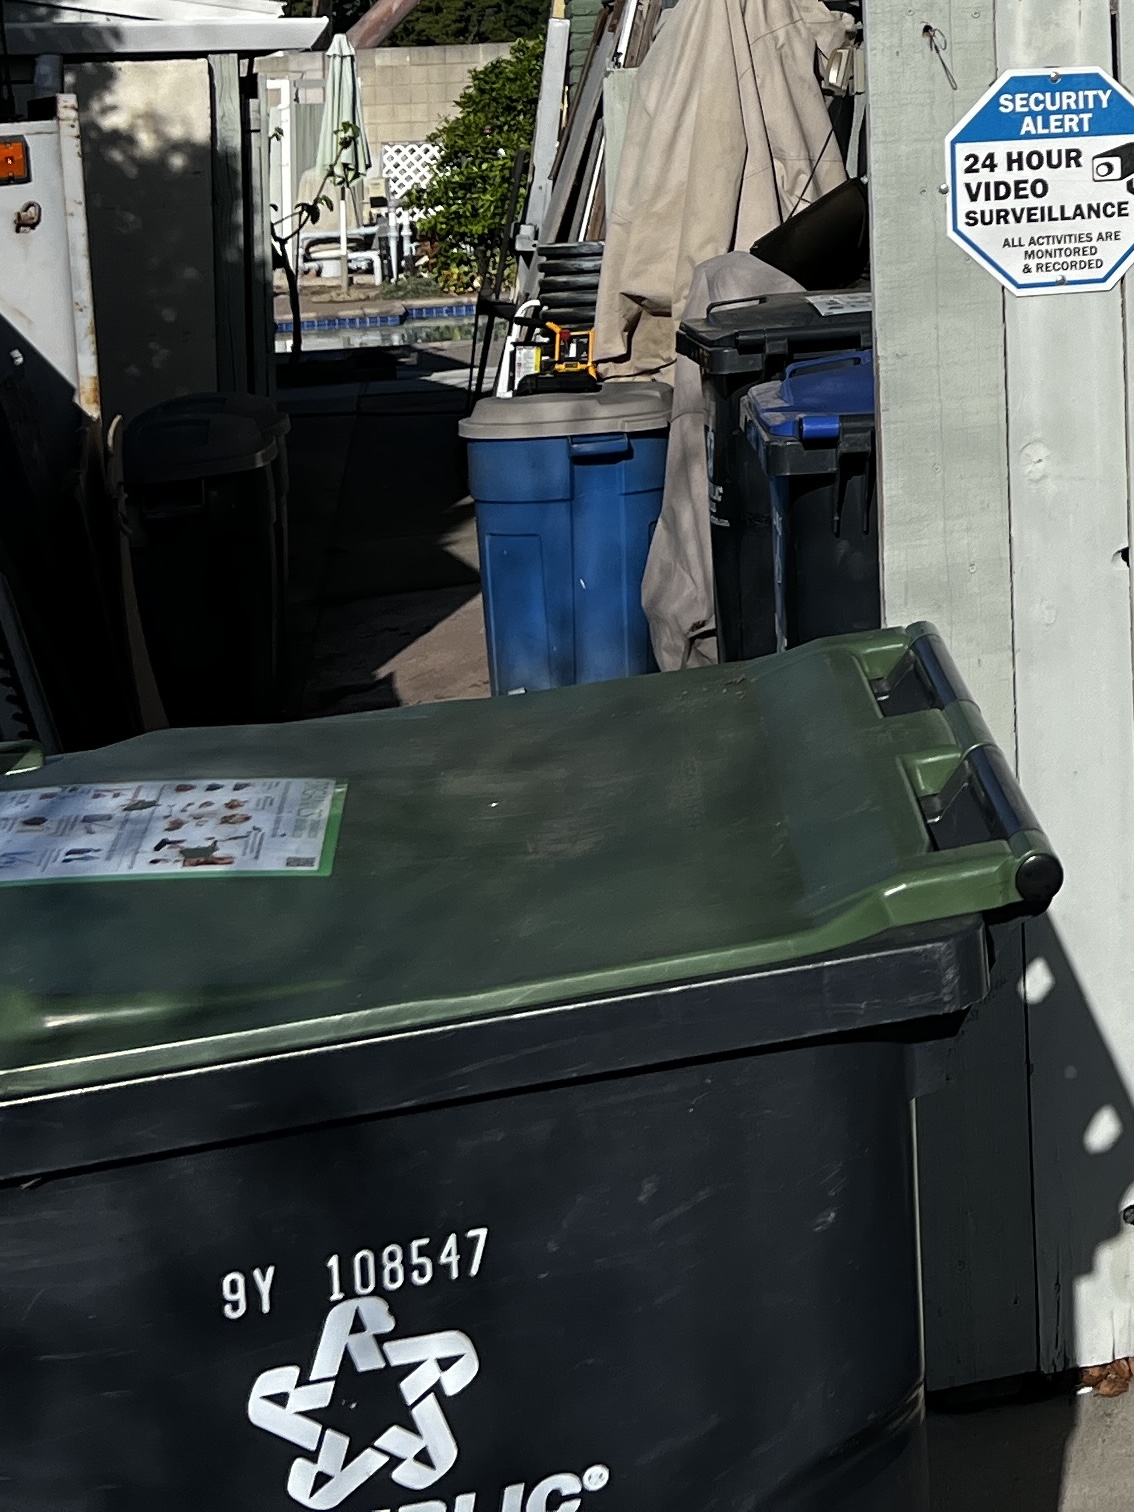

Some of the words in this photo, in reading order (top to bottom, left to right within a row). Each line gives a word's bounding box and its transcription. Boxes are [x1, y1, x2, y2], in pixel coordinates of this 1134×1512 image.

[998, 89, 1112, 113] SECURITY
[1020, 113, 1093, 135] ALERT
[963, 152, 998, 174] 24
[1006, 148, 1082, 172] HOUR
[964, 178, 1049, 202] VIDEO
[964, 201, 1129, 227] SURVEILLANCE
[1002, 237, 1025, 248] ALL
[1028, 233, 1093, 247] ACTIVITIES
[1096, 231, 1121, 242] ARE
[1024, 245, 1098, 260] MONITORED
[1022, 264, 1032, 274] &
[1035, 259, 1104, 273] RECORDED
[222, 1266, 275, 1319] 9Y
[327, 1228, 488, 1301] 108547
